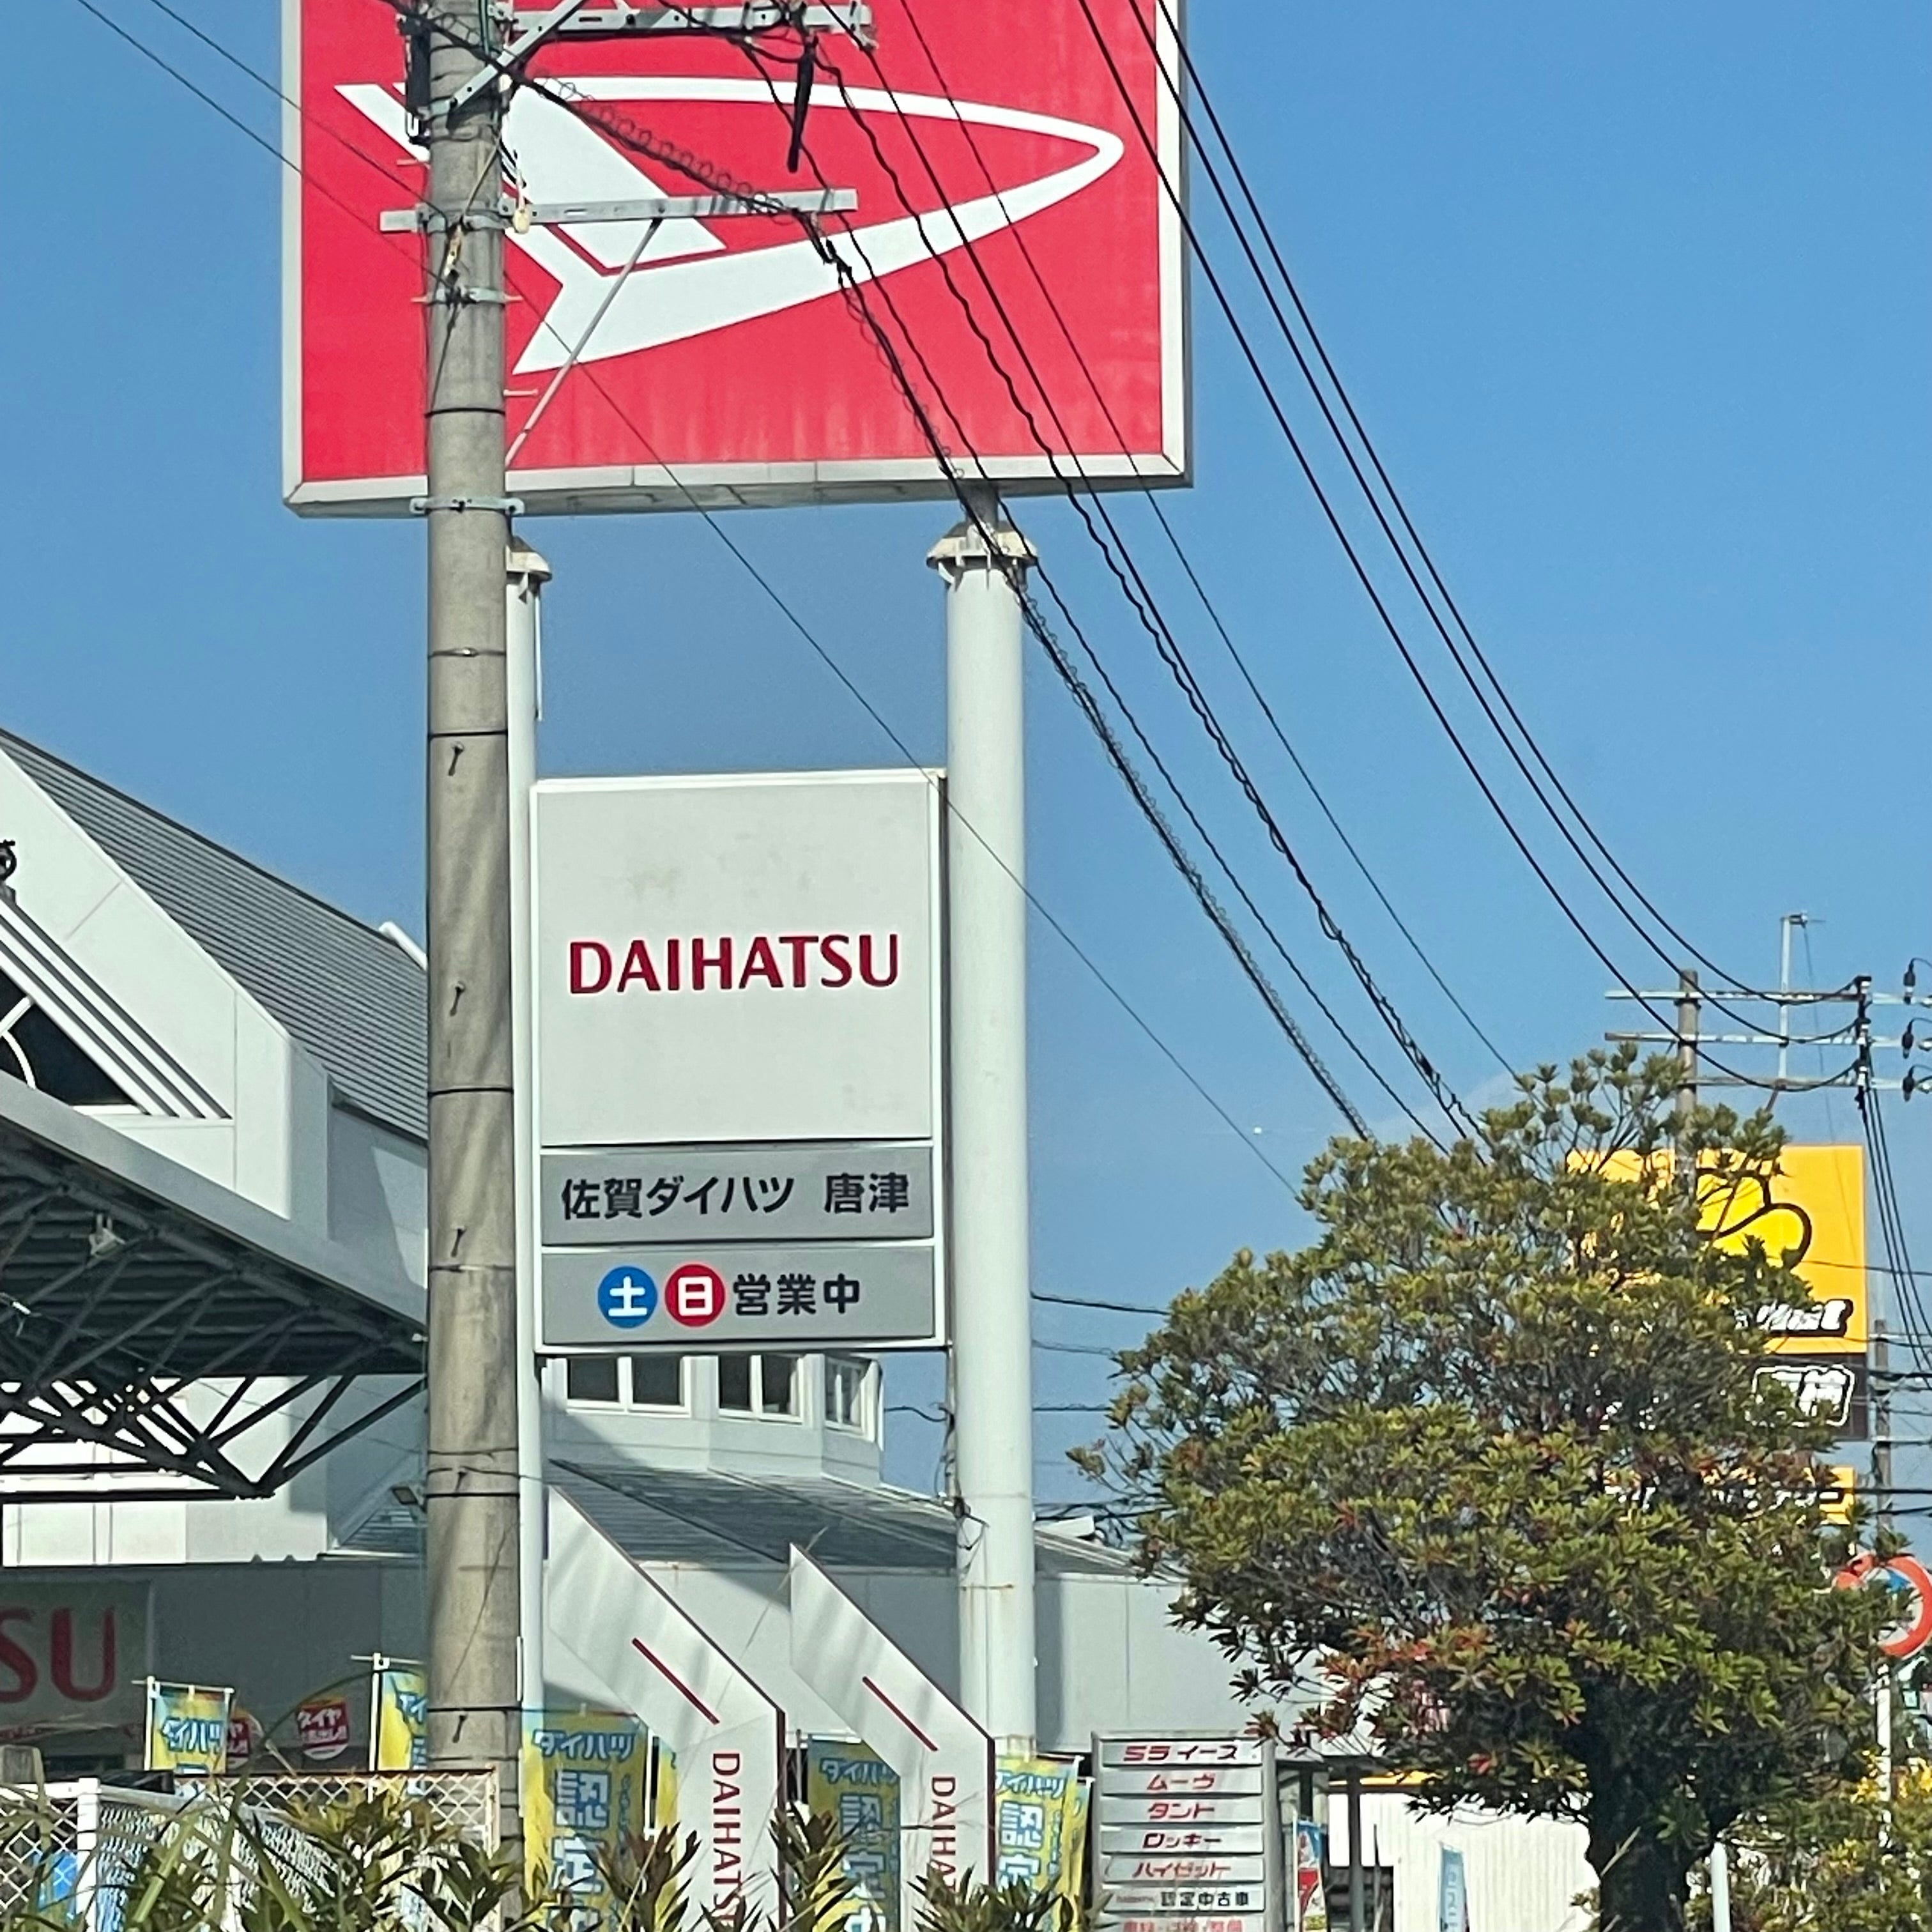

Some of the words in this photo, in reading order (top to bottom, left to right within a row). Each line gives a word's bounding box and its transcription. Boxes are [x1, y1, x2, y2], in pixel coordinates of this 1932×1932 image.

[569, 934, 898, 993] DAIHATSU
[561, 1174, 794, 1220] 佐賀ダイハツ
[824, 1172, 910, 1214] 唐津
[532, 1729, 638, 1761] ダイハツ
[1147, 1802, 1215, 1820] タント
[931, 1777, 956, 1892] DAIHA
[1142, 1833, 1222, 1849] ロッキー
[1132, 1862, 1232, 1878] ハイゼット
